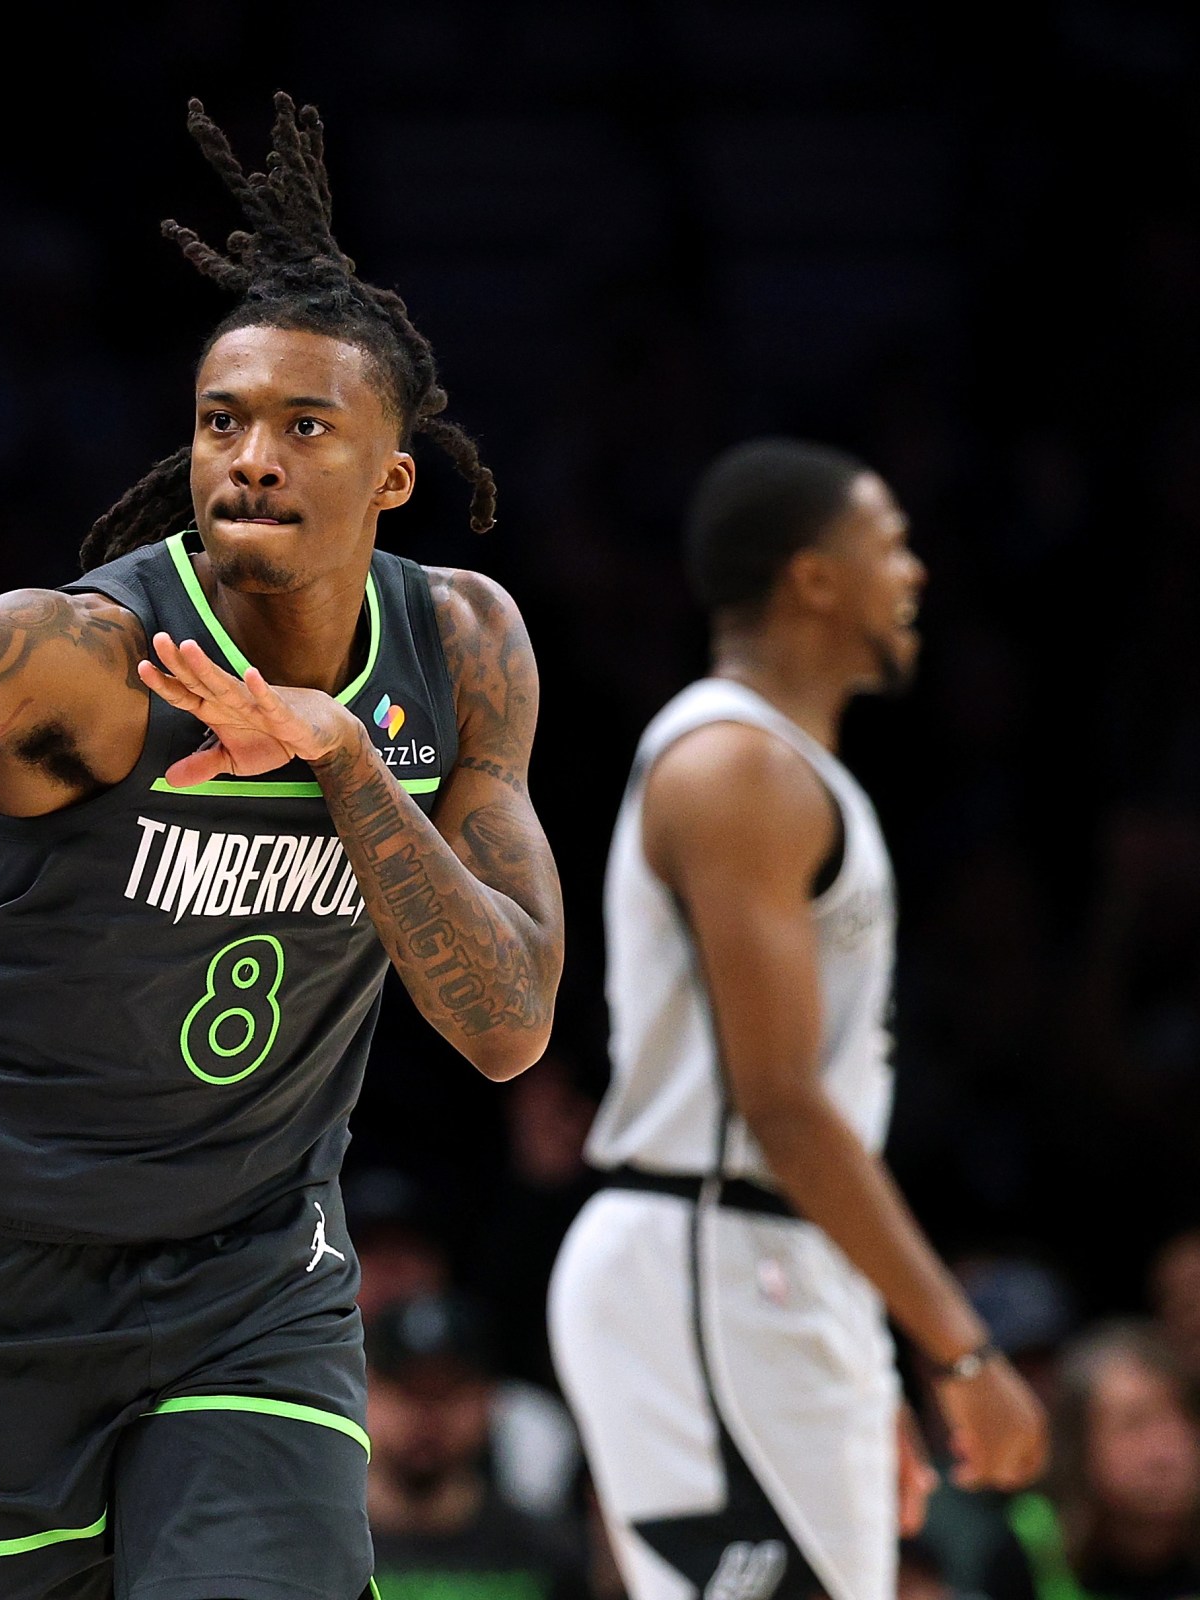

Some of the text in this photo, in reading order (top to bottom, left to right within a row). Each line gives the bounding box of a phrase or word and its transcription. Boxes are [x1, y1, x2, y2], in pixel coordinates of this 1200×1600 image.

[124, 815, 366, 927] TIMBERWOL
[346, 770, 504, 1037] WILMINGTON
[180, 934, 285, 1085] 8
